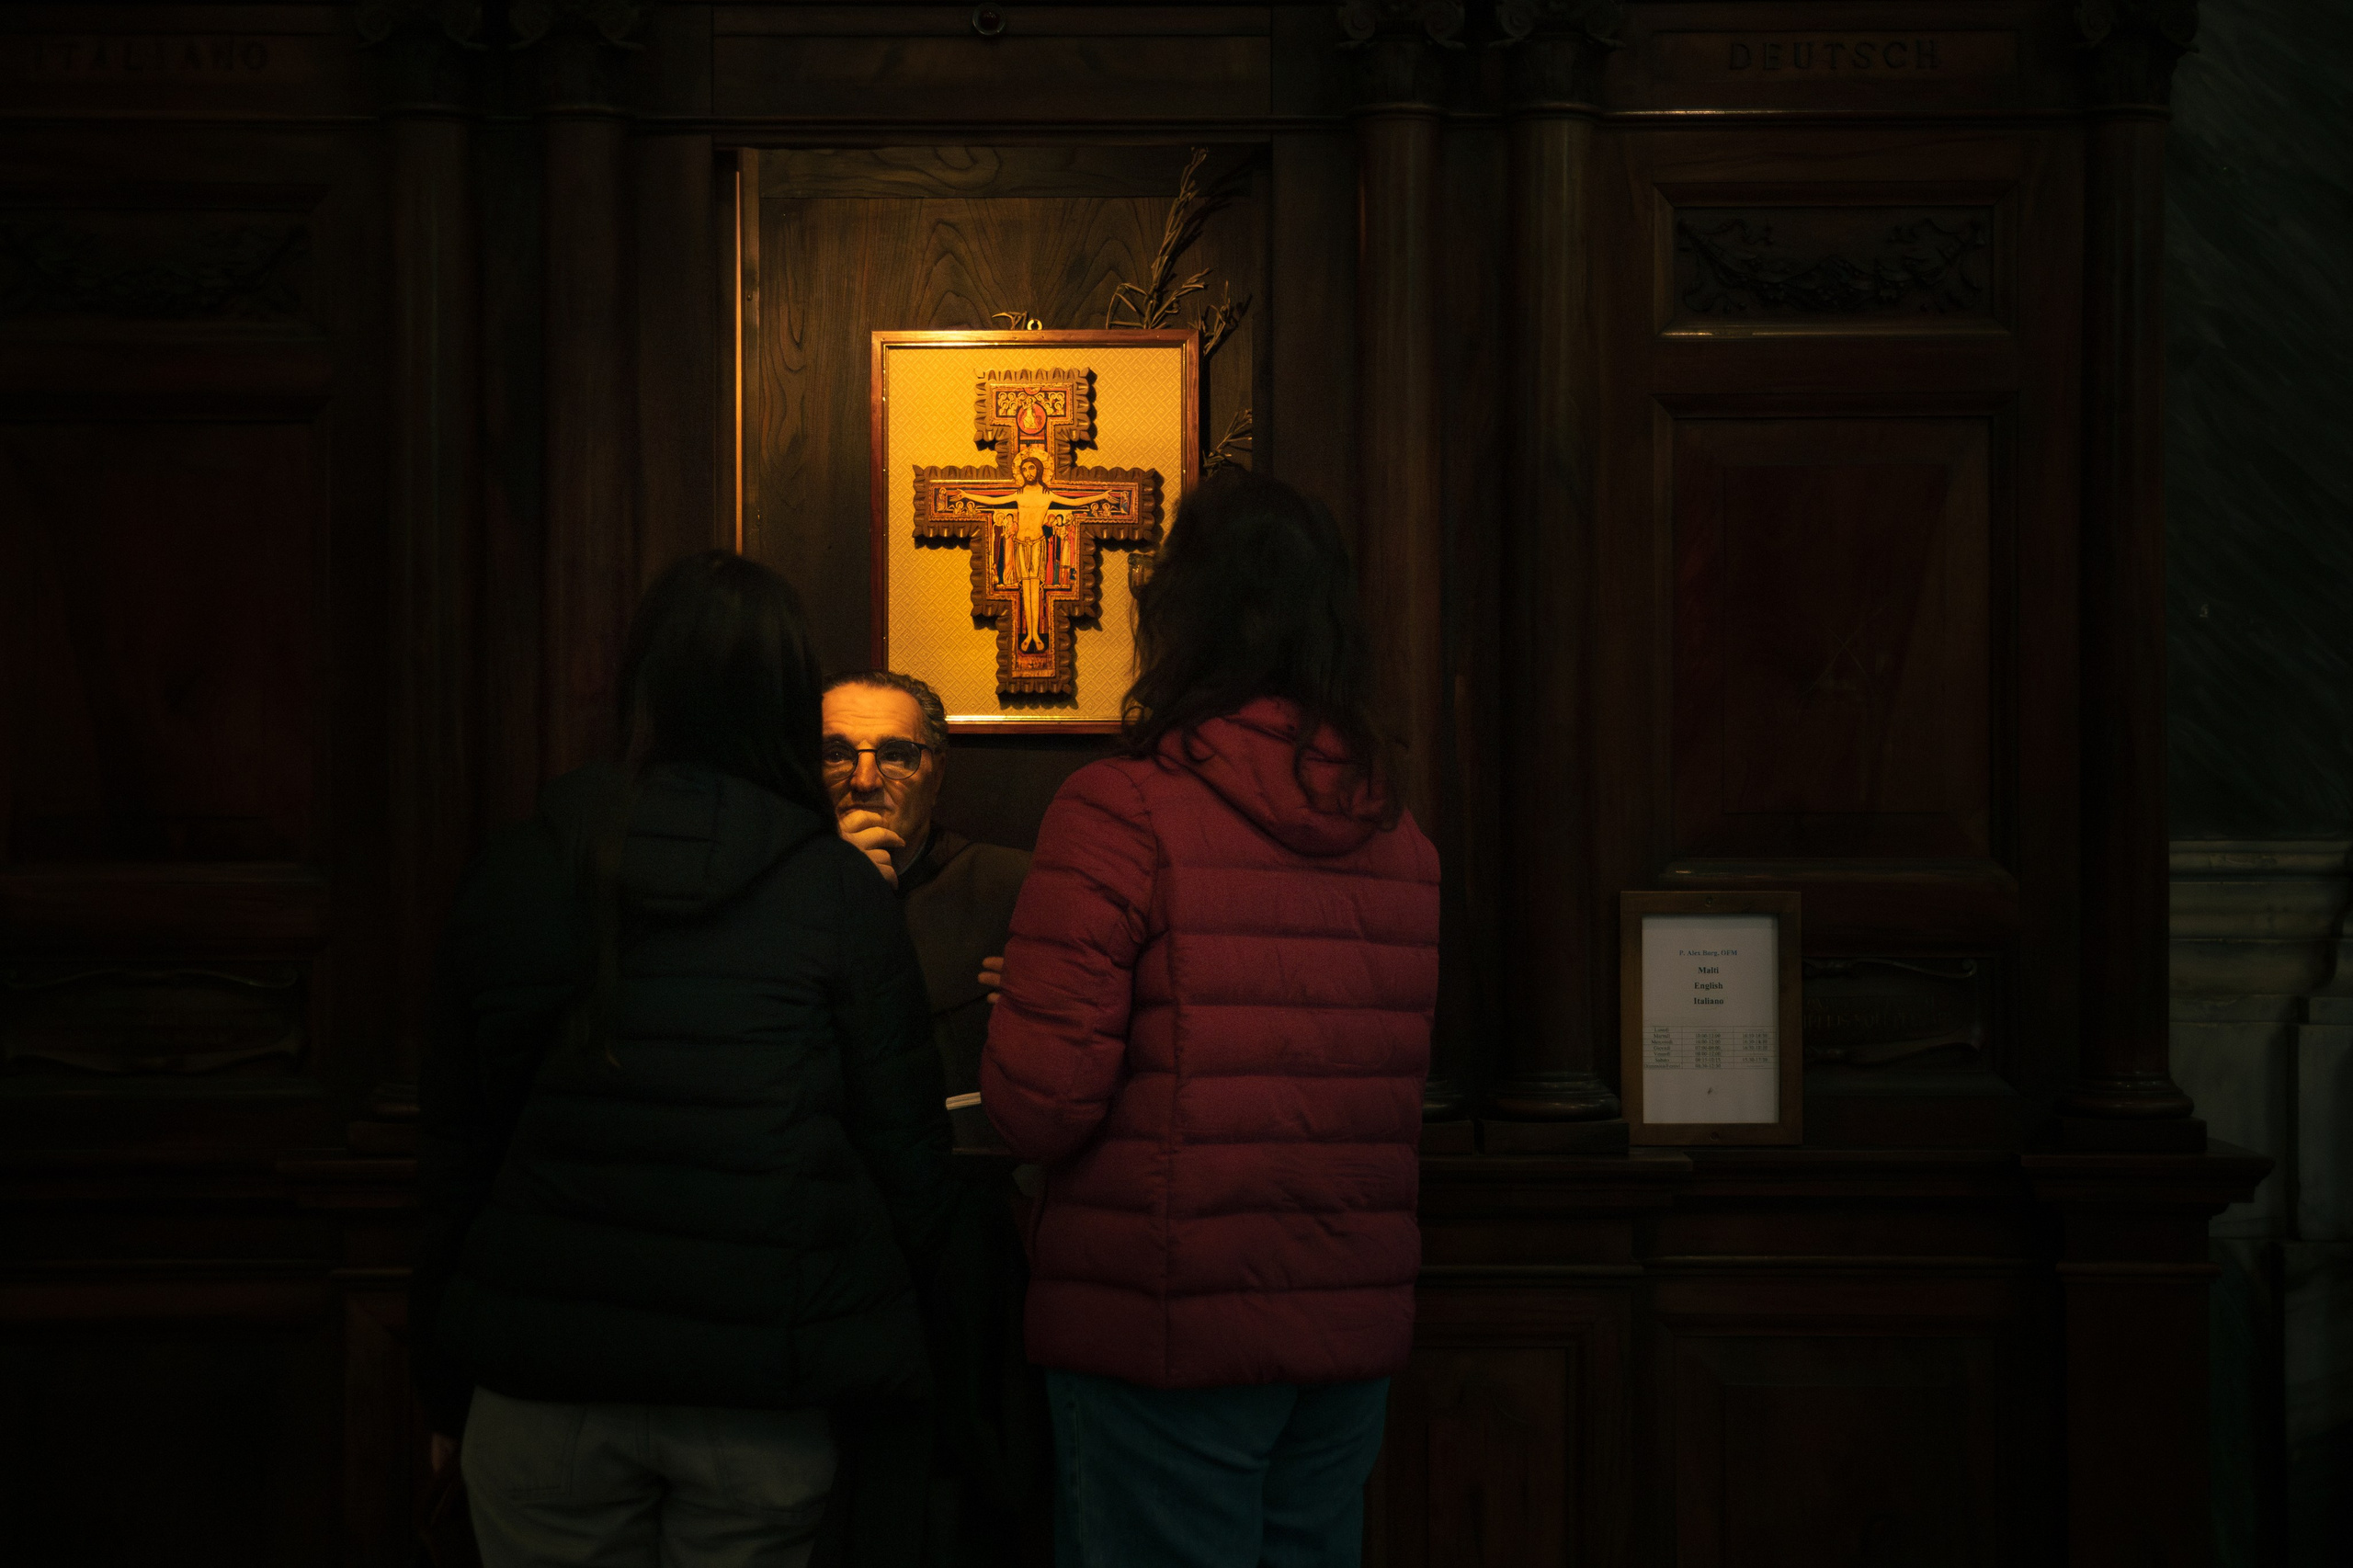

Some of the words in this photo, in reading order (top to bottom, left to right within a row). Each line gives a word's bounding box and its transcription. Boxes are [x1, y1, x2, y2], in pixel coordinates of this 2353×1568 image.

[33, 40, 268, 72] ITALIANO
[1729, 40, 1940, 71] DEUTSCH
[1694, 982, 1723, 991] English
